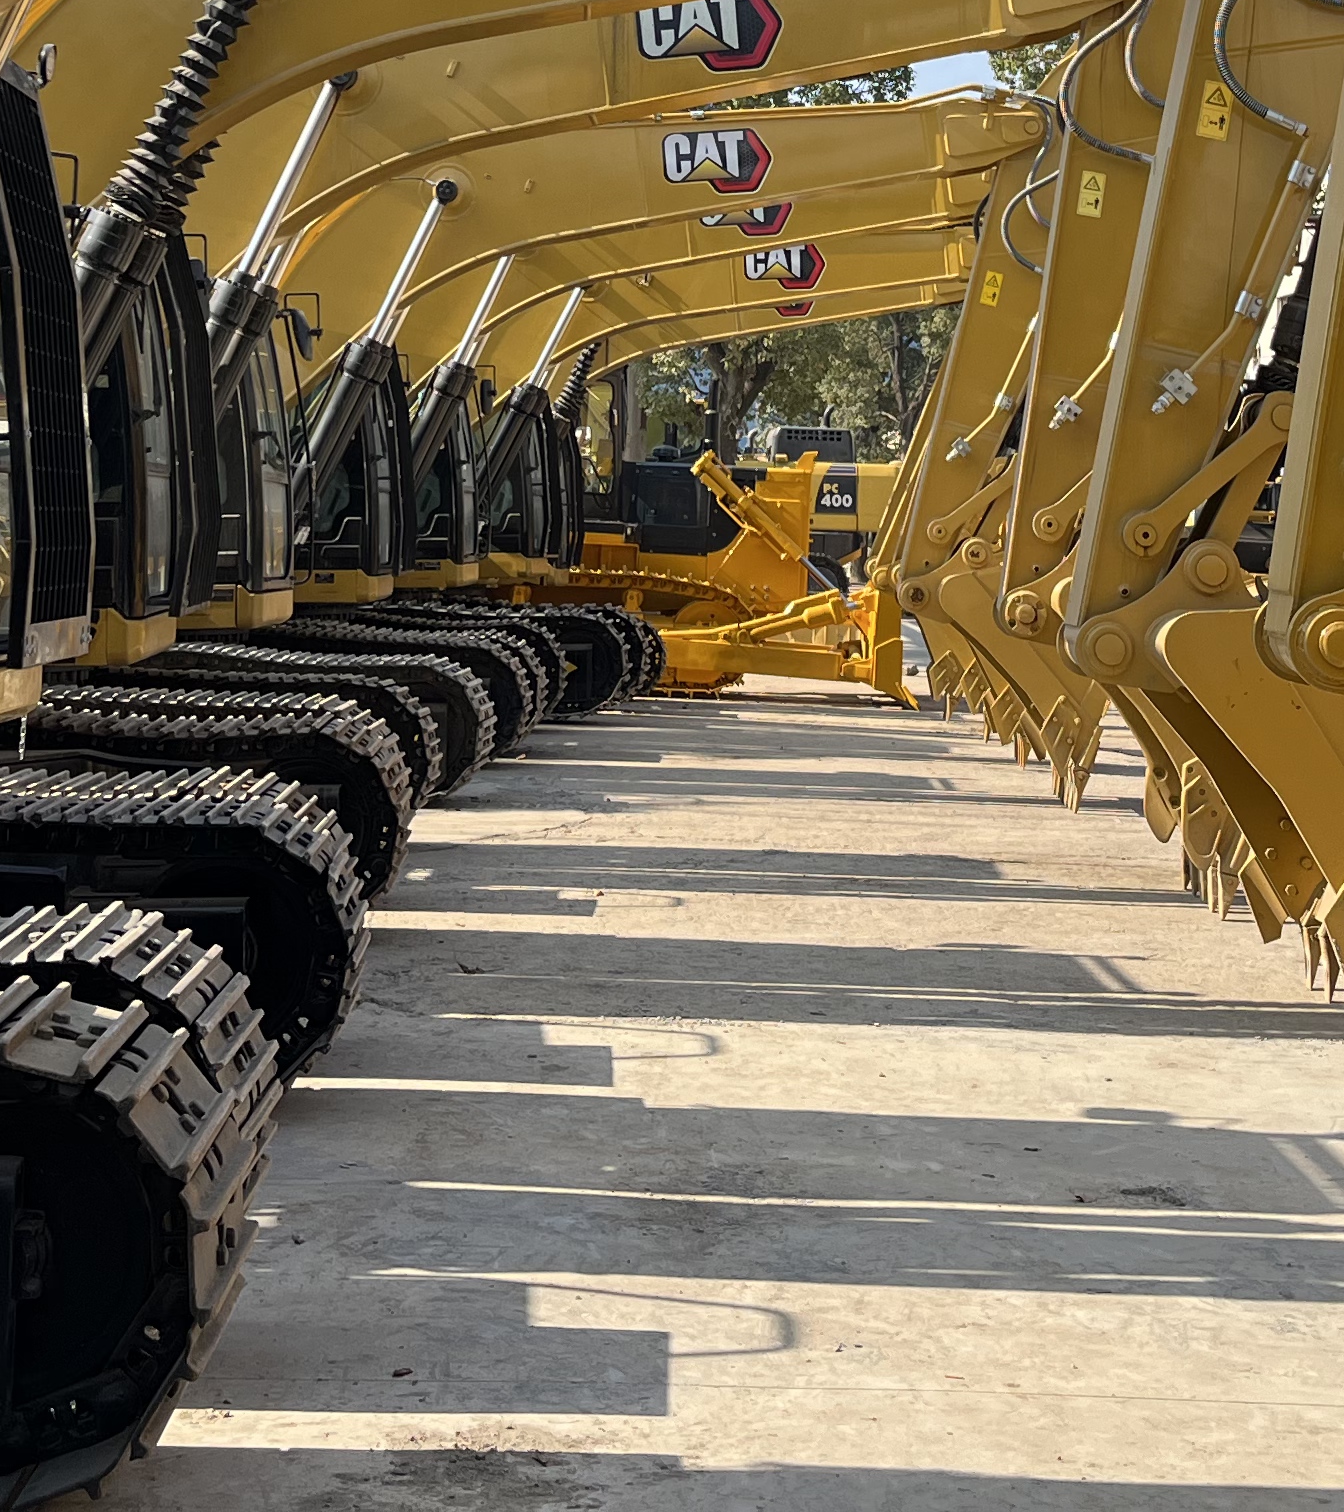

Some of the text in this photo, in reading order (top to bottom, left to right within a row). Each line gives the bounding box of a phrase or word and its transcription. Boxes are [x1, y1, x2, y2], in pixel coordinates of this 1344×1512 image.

[664, 130, 744, 182] CAT
[745, 244, 806, 280] CAT
[820, 494, 853, 508] 400
[823, 483, 839, 494] PC
